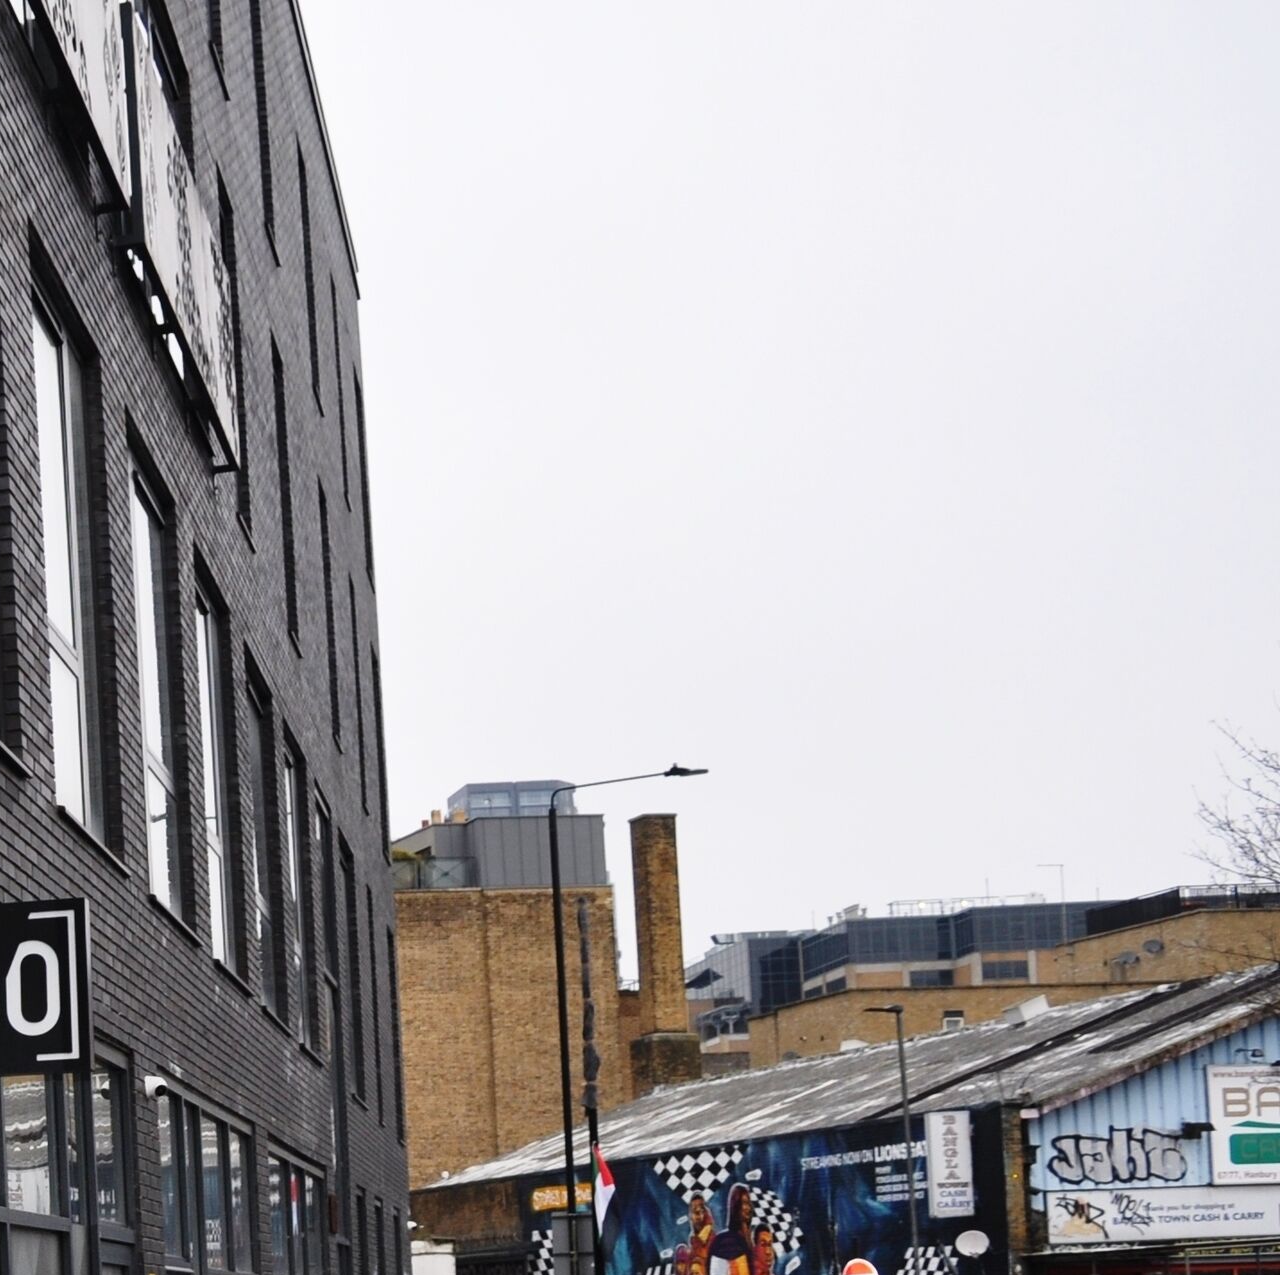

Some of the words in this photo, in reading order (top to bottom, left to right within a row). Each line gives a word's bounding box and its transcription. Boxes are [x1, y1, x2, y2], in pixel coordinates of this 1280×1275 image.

[942, 1115, 961, 1180] BANGLA
[1193, 1202, 1225, 1213] shopping
[1158, 1215, 1190, 1223] TOWN
[1192, 1213, 1221, 1222] CASH
[1232, 1212, 1265, 1221] CARRY
